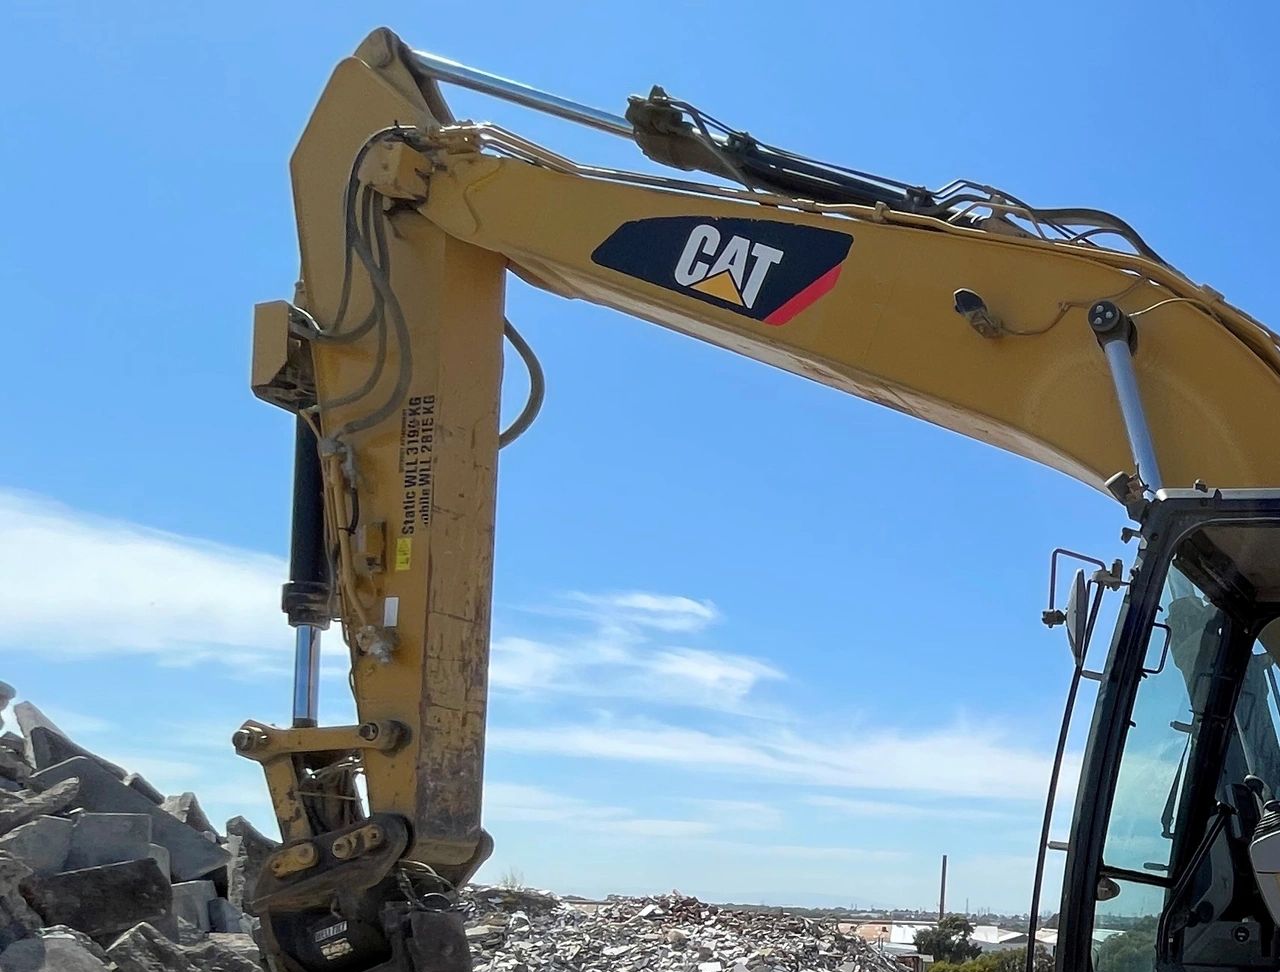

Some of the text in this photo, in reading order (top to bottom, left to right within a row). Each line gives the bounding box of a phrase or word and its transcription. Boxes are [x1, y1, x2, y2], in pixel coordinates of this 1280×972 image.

[674, 224, 784, 309] CAT
[408, 396, 421, 416] KG
[404, 457, 418, 488] WLL
[418, 456, 432, 486] WLL
[402, 490, 416, 535] Static
